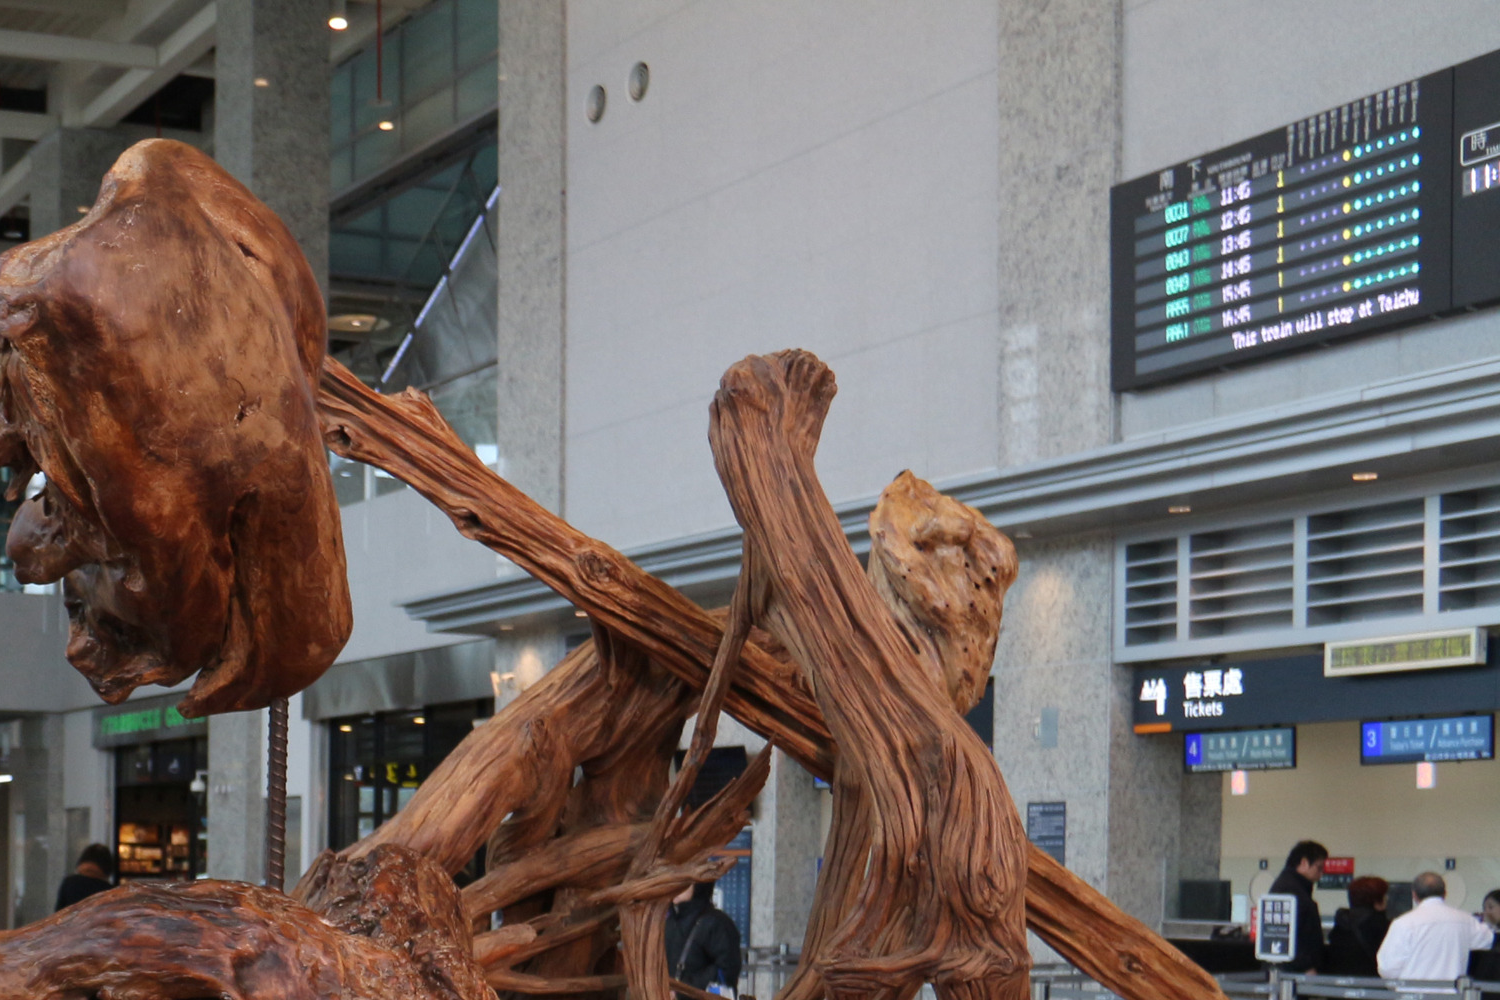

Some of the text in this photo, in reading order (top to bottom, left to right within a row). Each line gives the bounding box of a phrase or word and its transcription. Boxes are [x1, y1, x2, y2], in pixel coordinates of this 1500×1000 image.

[1470, 132, 1487, 151] 時
[1471, 161, 1500, 193] 11:
[1232, 288, 1420, 350] This train will stop at Taichu
[1183, 667, 1244, 700] 售票處
[1183, 701, 1224, 718] Tickets
[1367, 730, 1377, 748] 3
[1189, 741, 1198, 757] 4
